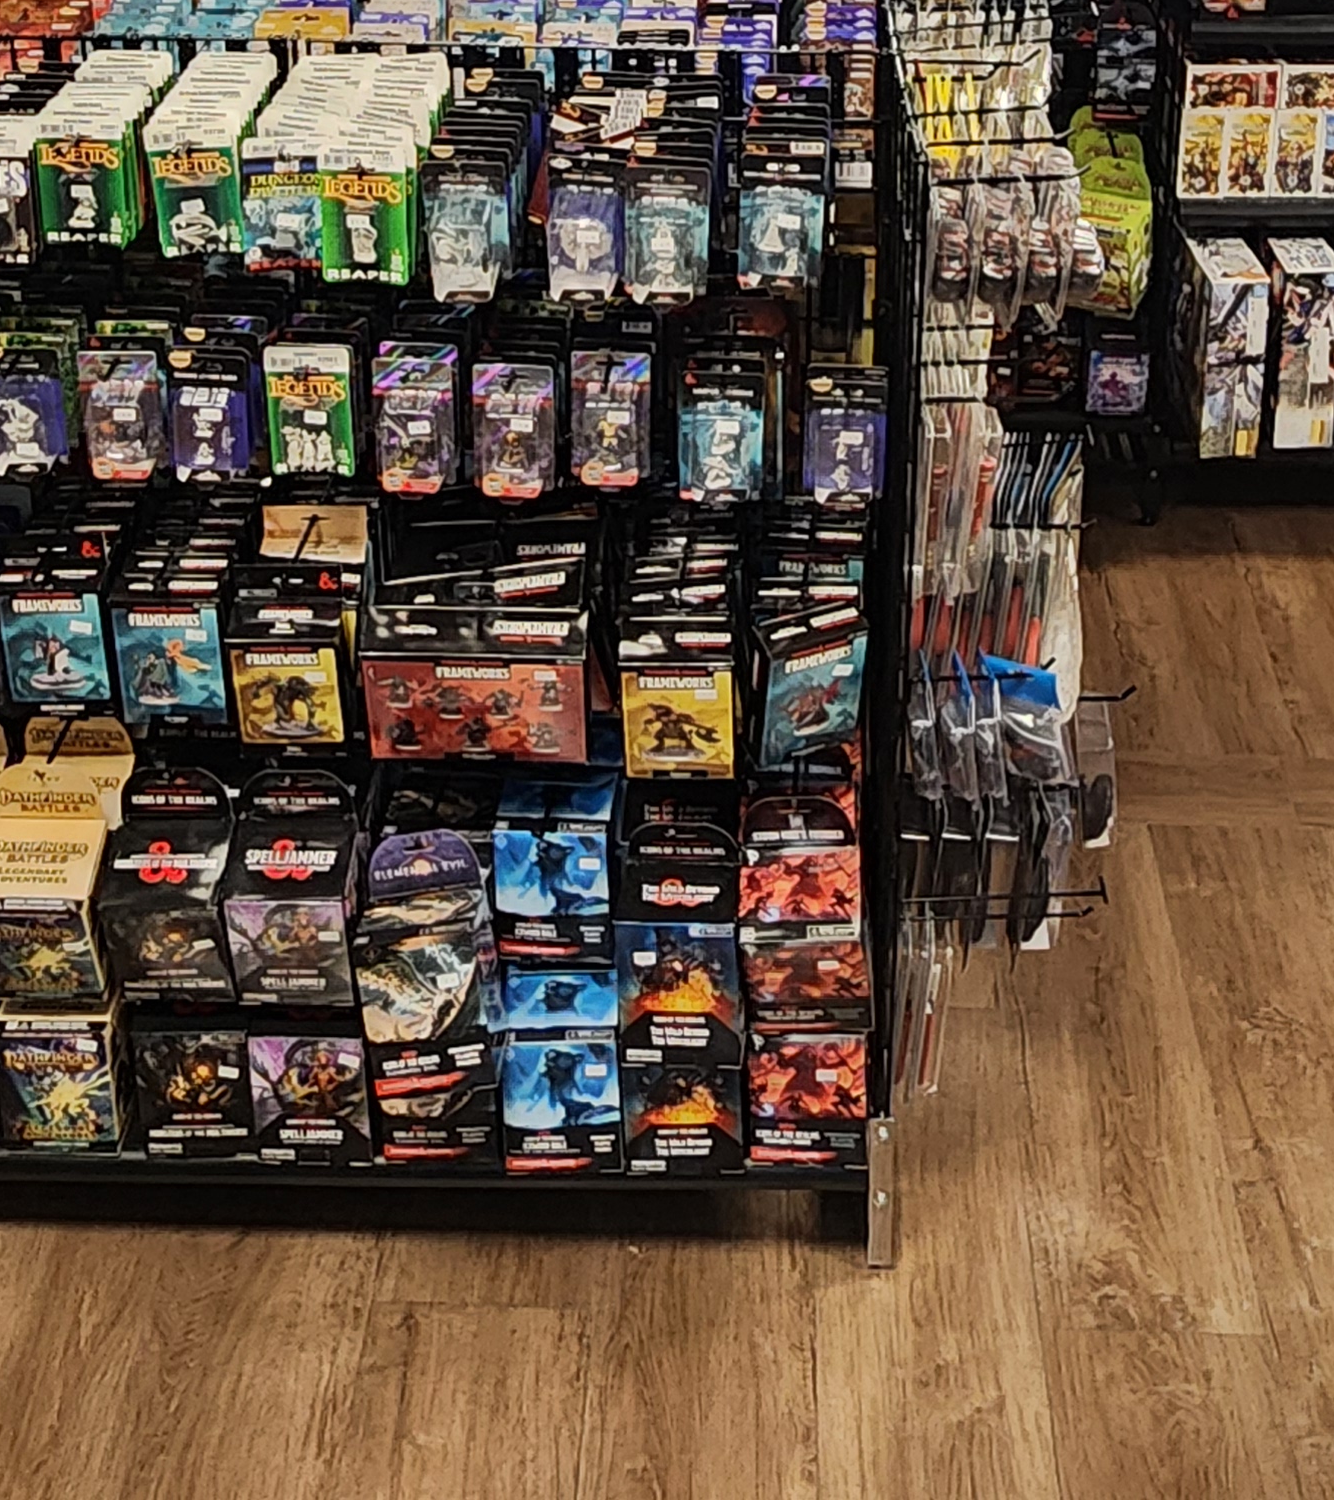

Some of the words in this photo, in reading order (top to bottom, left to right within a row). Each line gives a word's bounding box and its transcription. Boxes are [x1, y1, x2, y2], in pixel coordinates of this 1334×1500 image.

[37, 143, 120, 173] LEGENDS
[151, 156, 233, 185] LEGENDS
[322, 175, 405, 204] LEGENDS
[47, 231, 123, 245] REAPER
[327, 268, 404, 284] REAPER
[267, 375, 347, 407] LEGENDS
[12, 598, 84, 613] FRAMEWORKS
[128, 613, 201, 627] FRAMEWORKS
[245, 653, 320, 666] FRAMEWORKS
[784, 645, 852, 674] FRAMEWORKS
[435, 666, 512, 680] FRAMEWORKS
[638, 676, 715, 689] FRAMEWORKS
[20, 803, 81, 813] BATTLES
[7, 854, 69, 865] BATTLES
[244, 849, 338, 866] SPELLJAMMER
[3, 1049, 100, 1071] PATHFINDER
